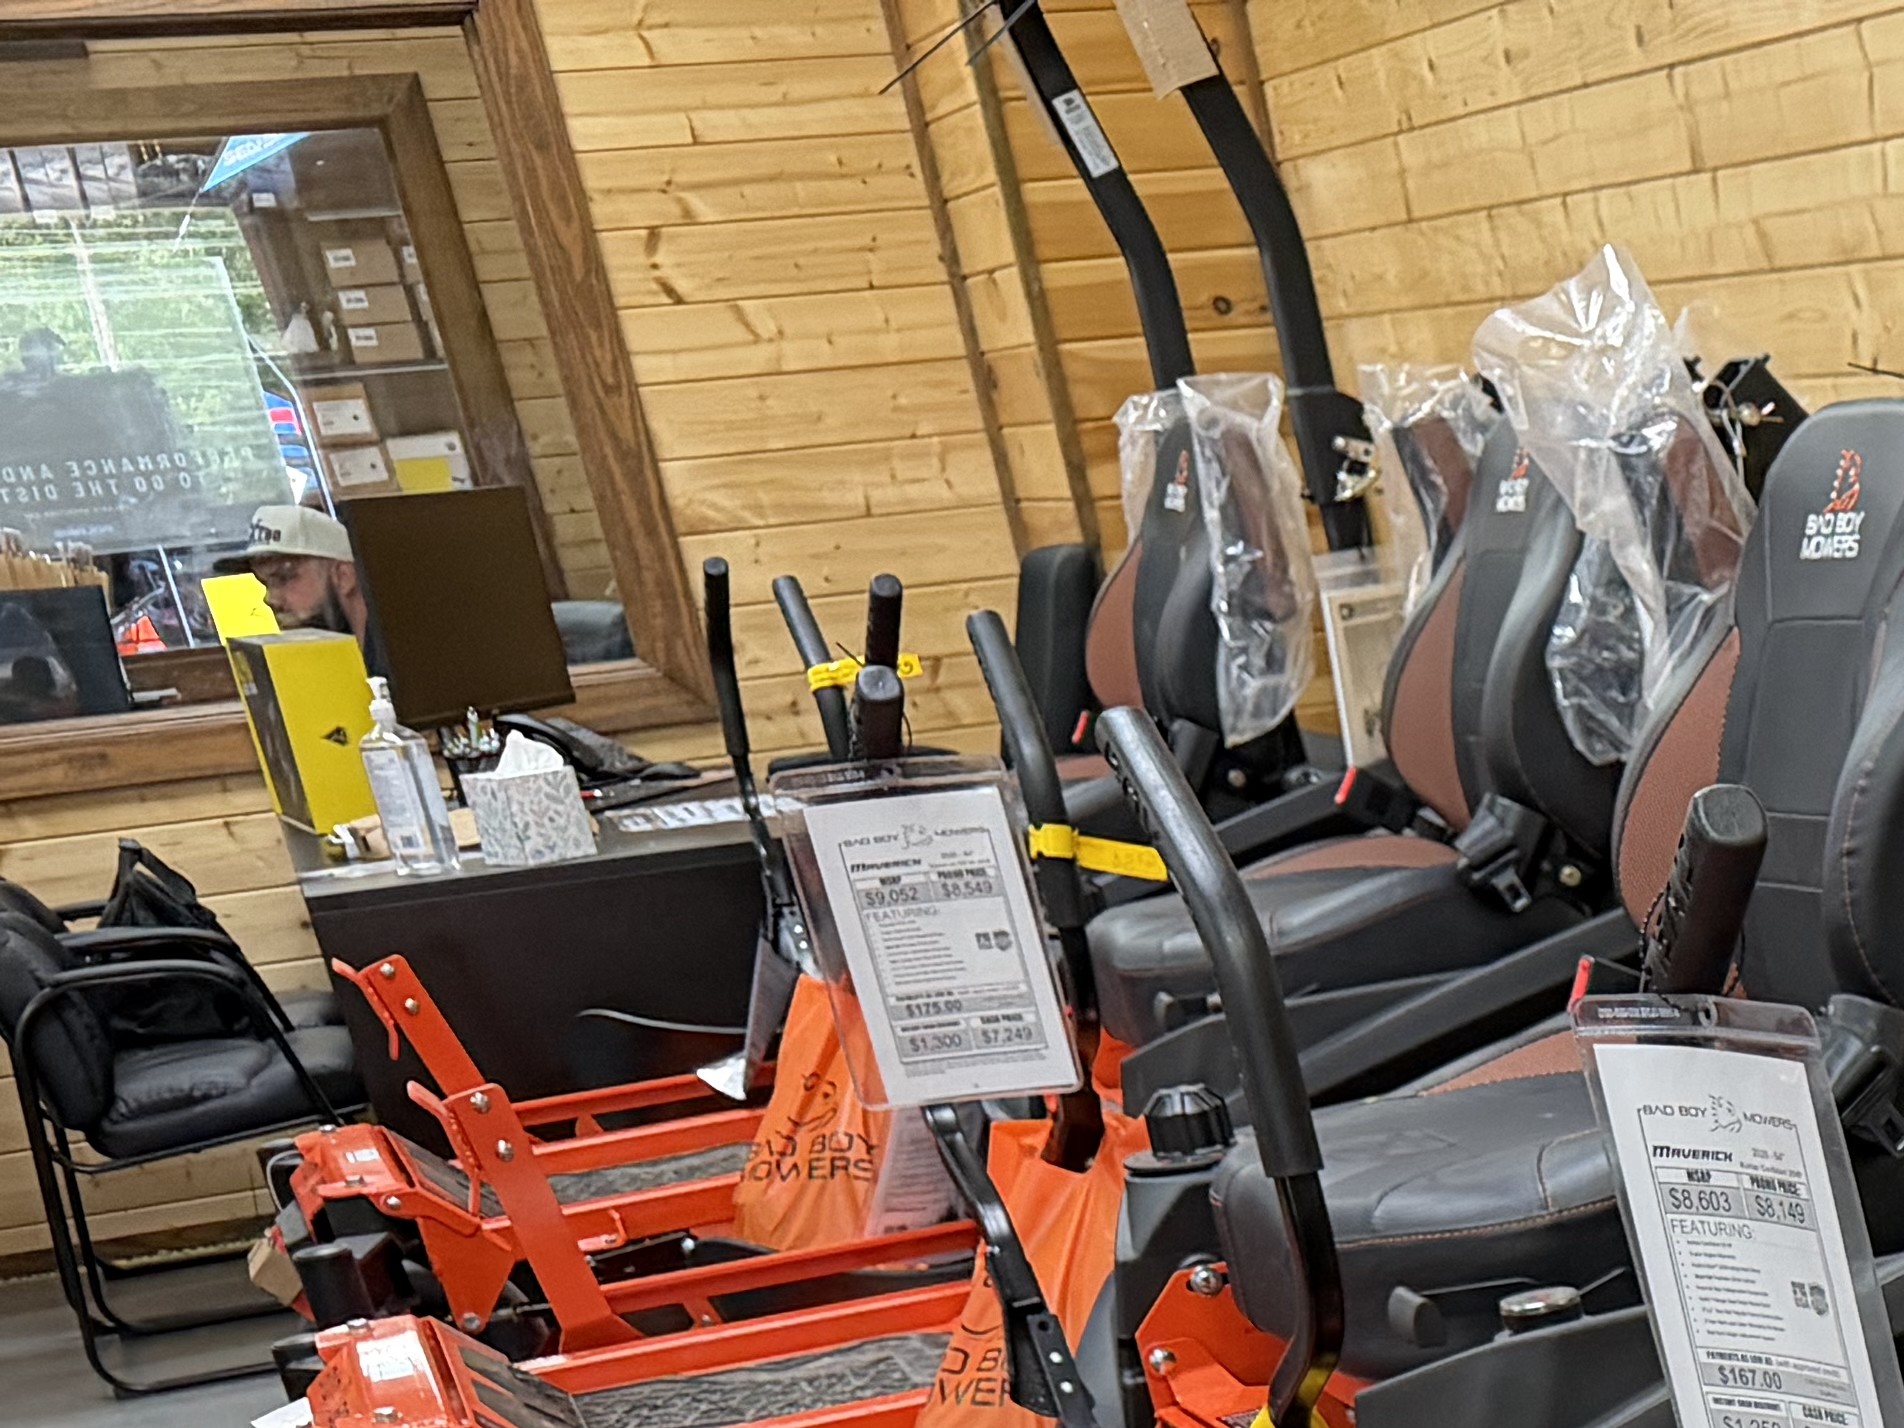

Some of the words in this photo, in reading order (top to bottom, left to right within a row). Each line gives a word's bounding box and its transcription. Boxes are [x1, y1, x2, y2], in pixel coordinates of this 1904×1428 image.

[865, 886, 918, 907] $9,052
[941, 880, 993, 898] $8,549
[1643, 1104, 1675, 1117] BAD
[1678, 1105, 1708, 1118] BOY
[1652, 1144, 1733, 1162] MAVERICK
[1669, 1186, 1732, 1213] $8,603
[1754, 1194, 1805, 1224] $8,149
[1670, 1218, 1756, 1240] FEATURING:
[1718, 1365, 1782, 1390] $167.00
